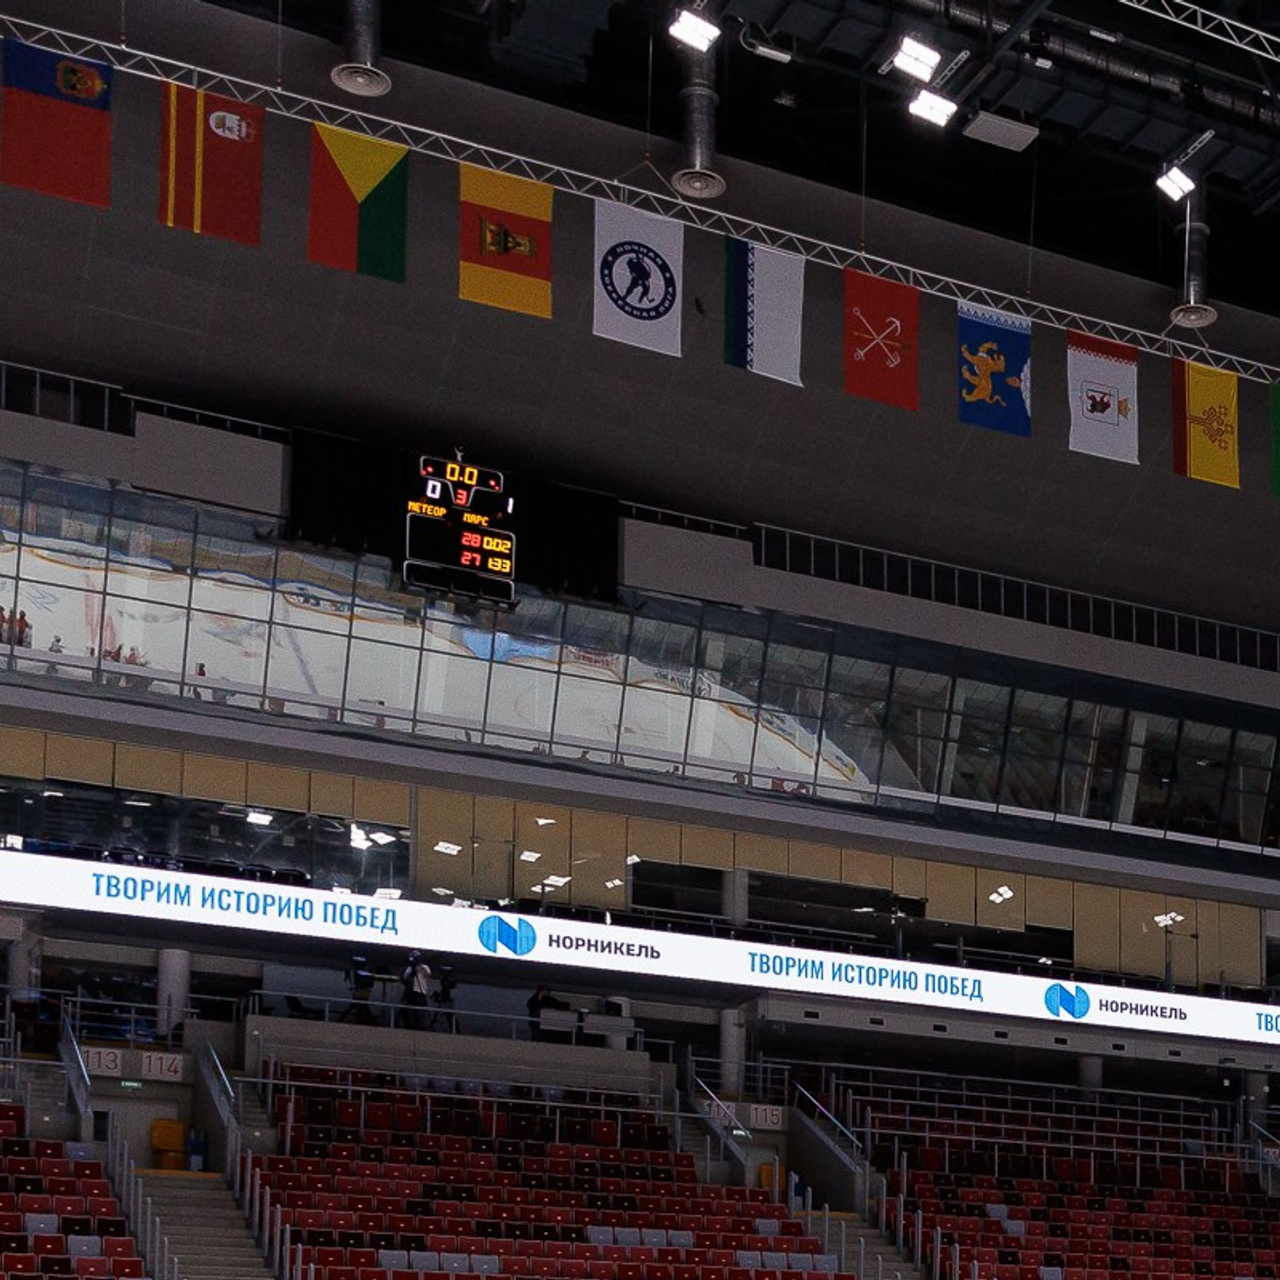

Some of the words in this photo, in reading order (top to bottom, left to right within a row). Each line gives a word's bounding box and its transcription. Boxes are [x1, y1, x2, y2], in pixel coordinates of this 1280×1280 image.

[426, 480, 441, 499] 0
[456, 489, 468, 505] 3
[408, 501, 447, 517] МЕТЕОР
[463, 512, 489, 526] МАРС
[461, 532, 481, 547] 28
[461, 551, 481, 566] 27
[93, 873, 191, 907] ТВОРИМ
[201, 886, 314, 921] ИСТОРИЮ
[322, 902, 399, 935] ПОБЕД
[548, 934, 661, 960] НОРНИКЕЛЬ
[749, 952, 824, 980] ТВОРИМ
[832, 962, 918, 991] ИСТОРИЮ
[925, 973, 984, 1002] ПОБЕД
[1099, 999, 1188, 1020] НОРНИКЕЛЬ
[83, 1050, 119, 1071] 113
[144, 1055, 180, 1076] 114
[752, 1107, 781, 1126] 115
